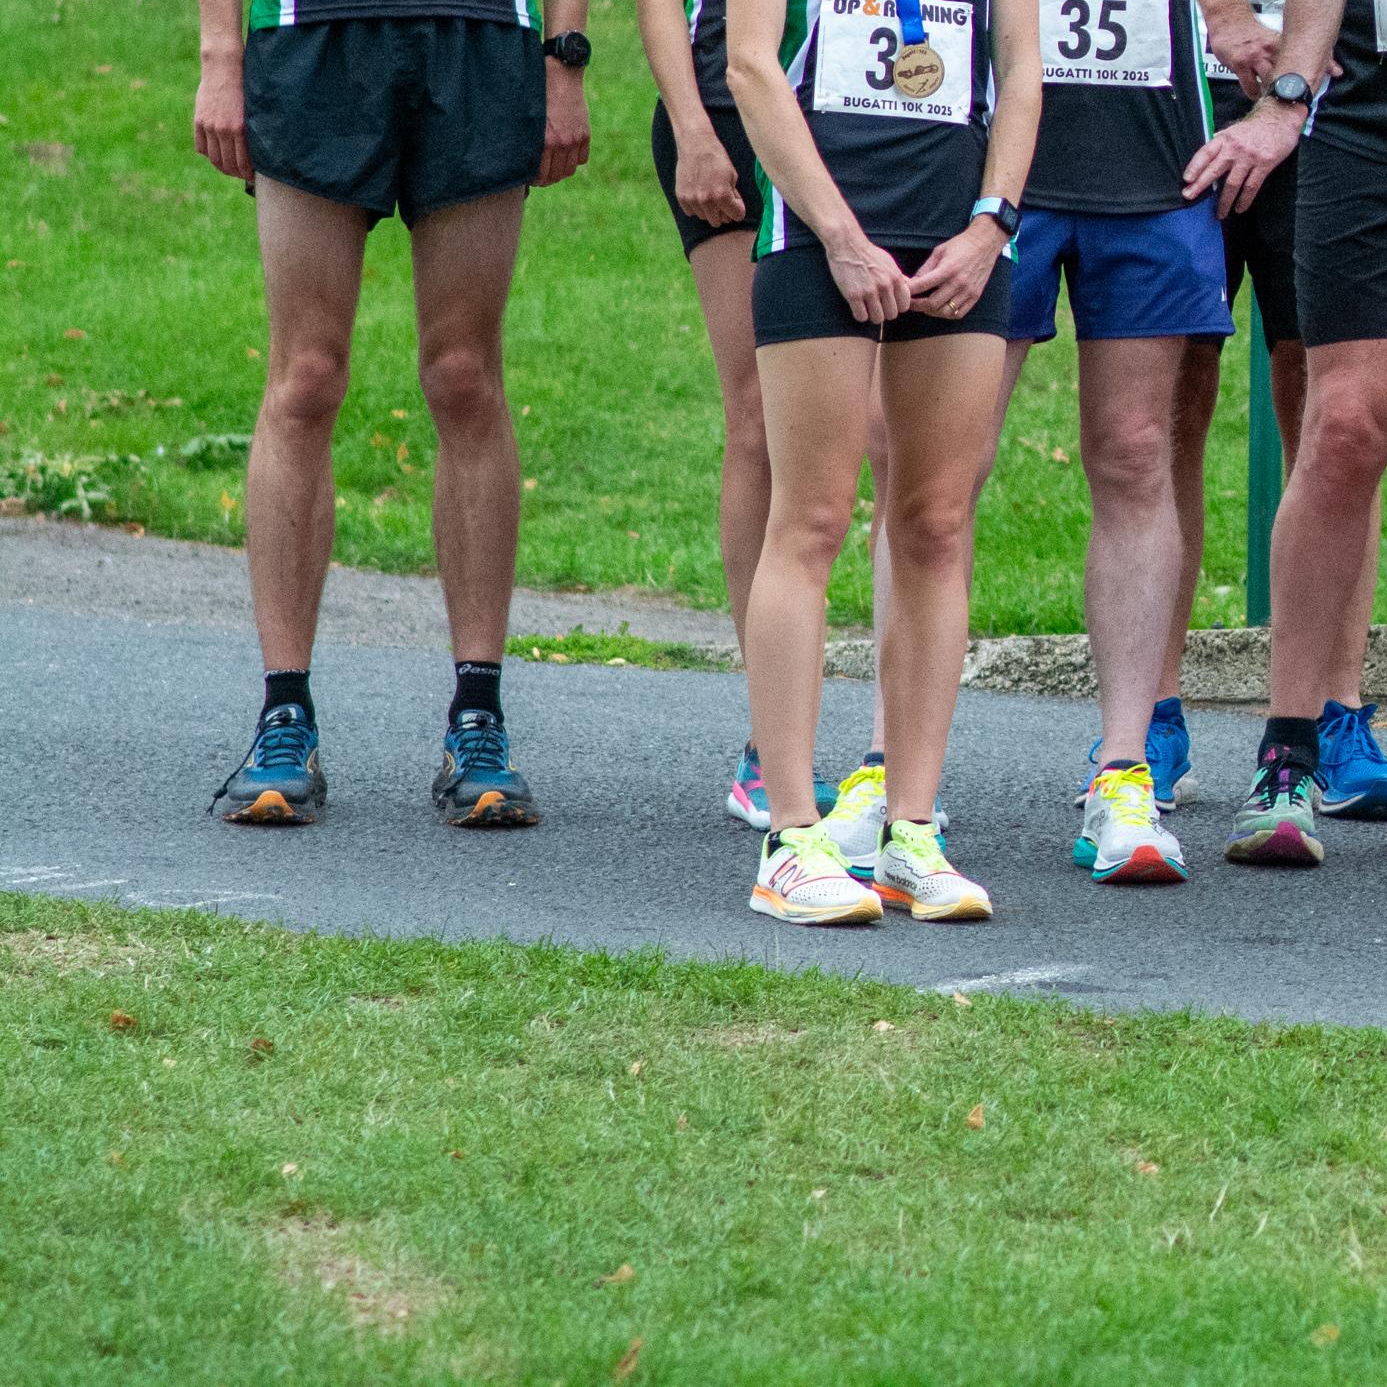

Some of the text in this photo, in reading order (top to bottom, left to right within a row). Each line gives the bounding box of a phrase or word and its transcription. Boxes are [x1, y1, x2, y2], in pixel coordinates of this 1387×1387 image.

[883, 0, 968, 26] RNING
[1096, 69, 1117, 80] 10K
[1123, 71, 1149, 81] 2025
[844, 97, 952, 116] BUGATTI 10K 2025
